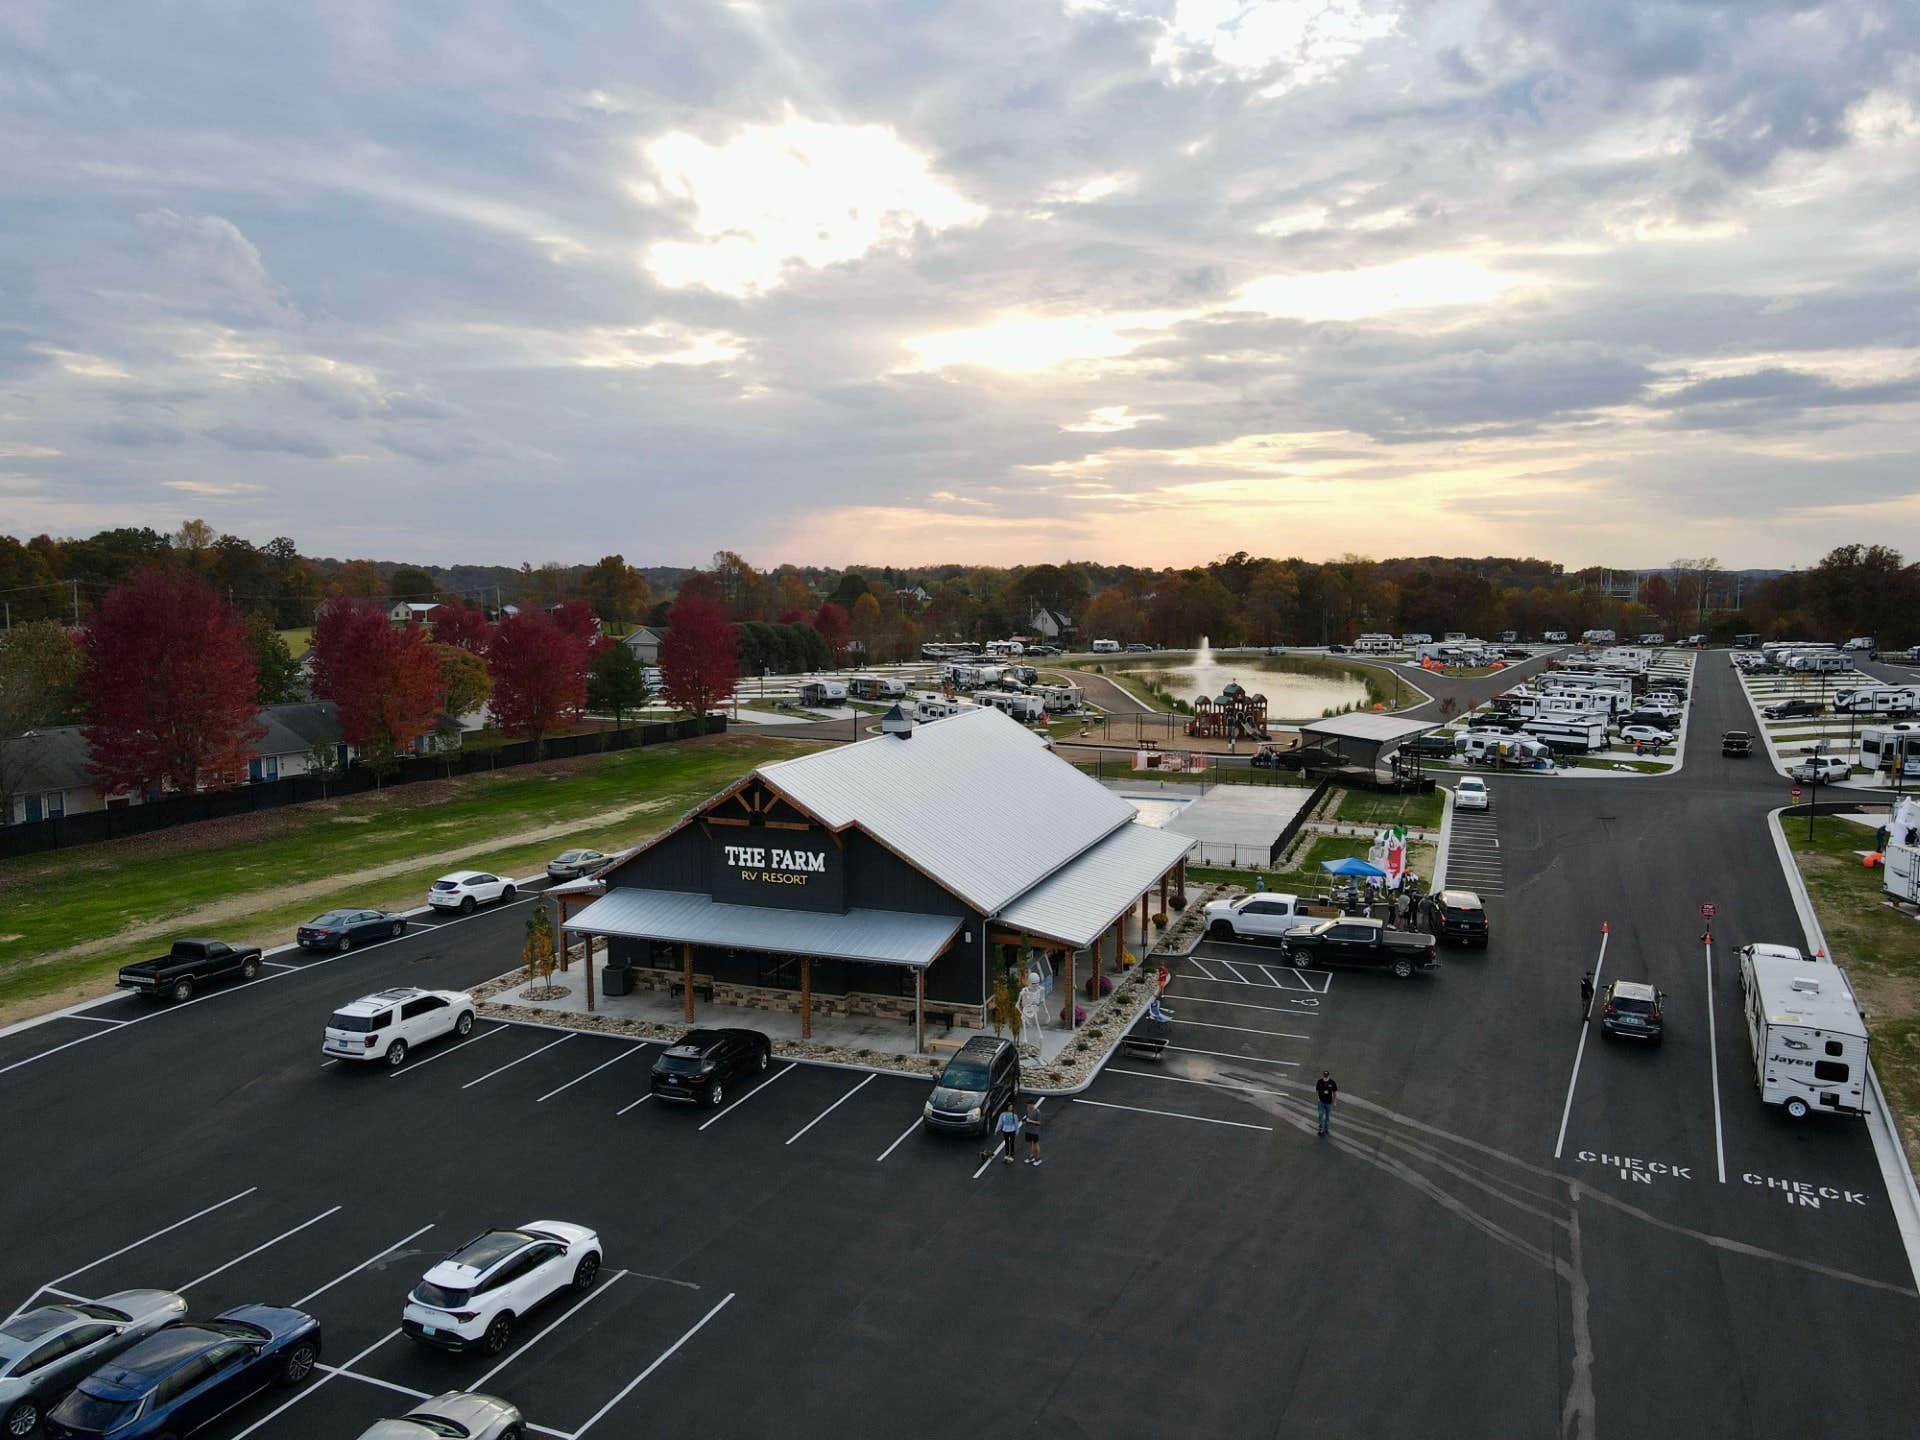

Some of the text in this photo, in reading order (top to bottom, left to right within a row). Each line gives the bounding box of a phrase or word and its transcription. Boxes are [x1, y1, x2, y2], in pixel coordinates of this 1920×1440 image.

[725, 846, 825, 872] THE FARM
[741, 870, 808, 885] RV RESORT
[1769, 1054, 1814, 1067] Jayco
[1578, 1151, 1692, 1180] CHECK
[1620, 1169, 1651, 1184] IN
[1743, 1173, 1866, 1206] CHECK
[1786, 1192, 1820, 1209] IN
